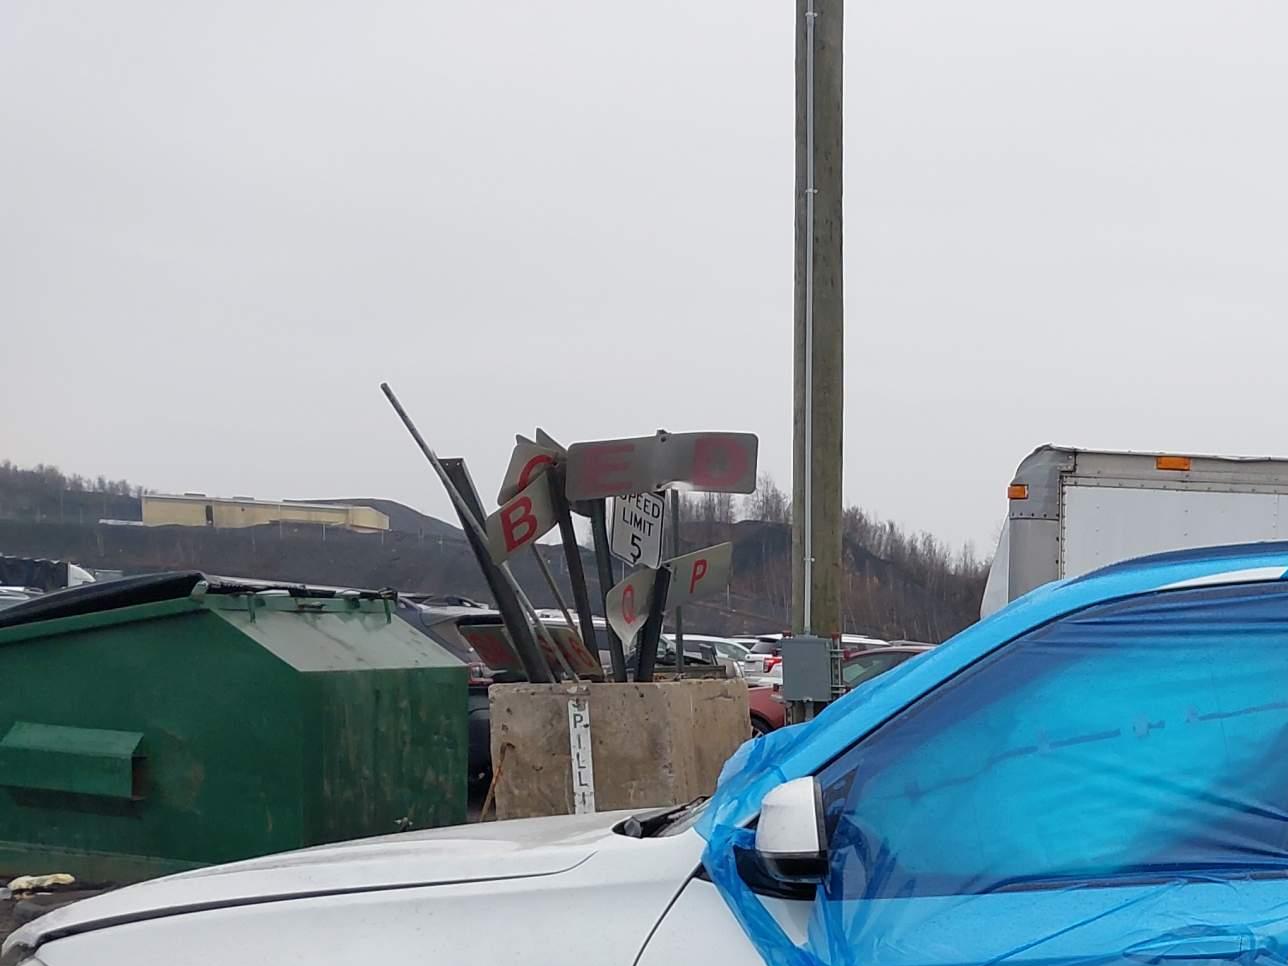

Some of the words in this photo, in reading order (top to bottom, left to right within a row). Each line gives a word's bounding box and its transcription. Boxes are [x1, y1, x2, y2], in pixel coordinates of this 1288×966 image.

[500, 495, 538, 553] B
[622, 506, 654, 537] LIMIT
[630, 533, 642, 563] 5
[689, 559, 708, 594] P
